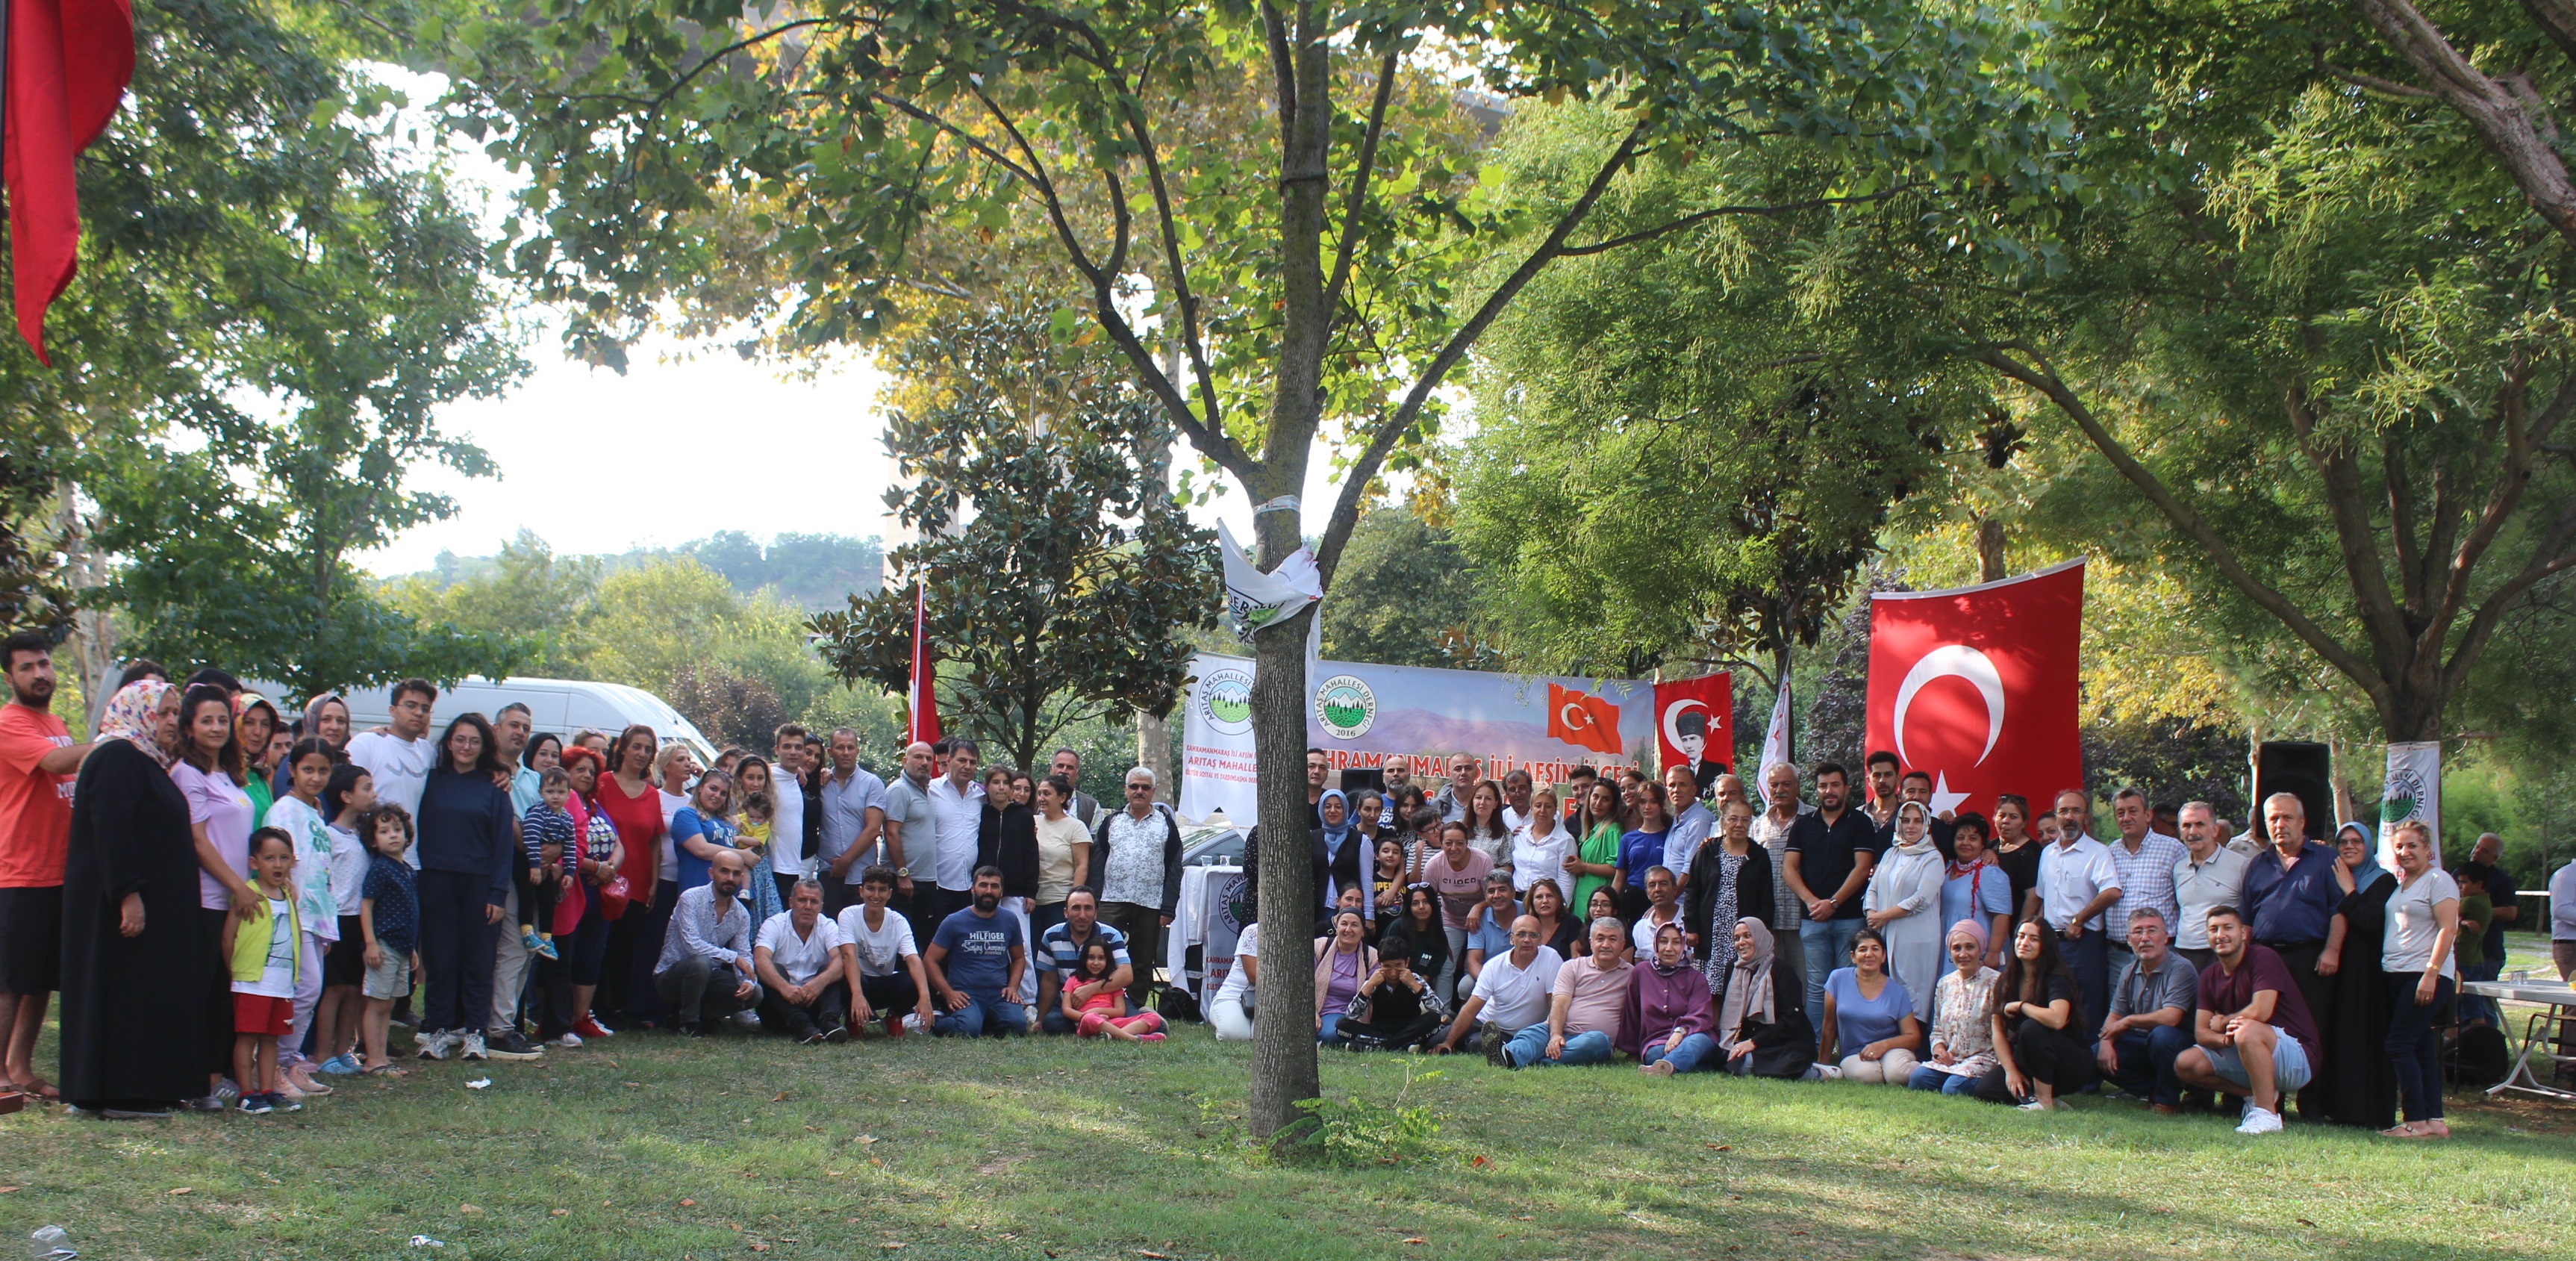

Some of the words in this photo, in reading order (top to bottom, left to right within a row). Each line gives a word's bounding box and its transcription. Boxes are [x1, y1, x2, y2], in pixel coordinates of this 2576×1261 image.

[1206, 673, 1253, 689] MAHALLESİ
[1320, 679, 1364, 696] MAHALLESİ
[1363, 691, 1373, 729] DERNEĞİ
[1186, 744, 1230, 758] KAHRAMANMARAŞ
[1188, 756, 1217, 770] ARITAŞ
[1200, 770, 1213, 779] SOSYAL
